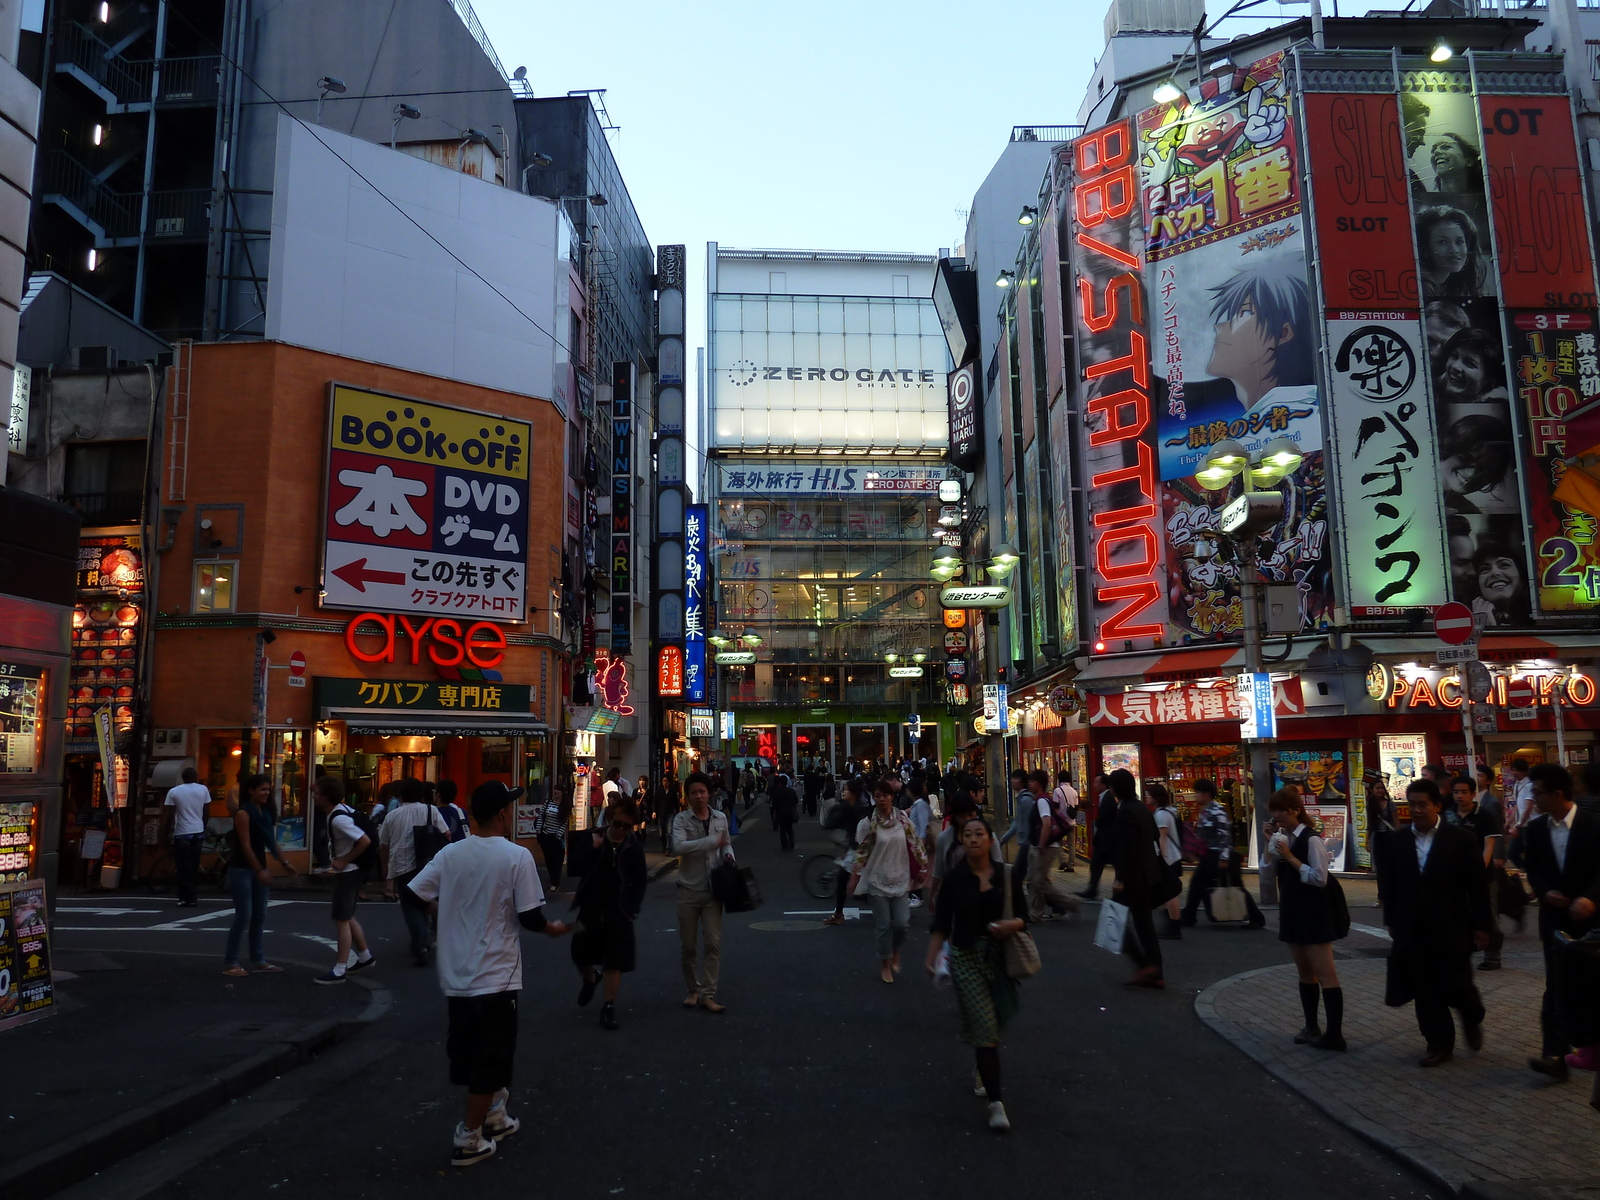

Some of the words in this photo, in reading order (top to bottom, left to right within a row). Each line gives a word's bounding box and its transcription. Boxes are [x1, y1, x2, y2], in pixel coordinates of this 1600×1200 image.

[1149, 177, 1189, 211] 2F
[1336, 217, 1388, 232] SLOT
[1339, 312, 1405, 320] BB/STATION
[1535, 315, 1570, 329] 3F
[1160, 265, 1187, 420] パチンコも最高だね。
[763, 367, 849, 381] ZERO
[856, 368, 934, 382] GATE
[1072, 119, 1164, 641] BB/STATION
[953, 412, 974, 432] NIJYU
[953, 427, 975, 444] MARU
[959, 442, 969, 455] 5F
[727, 471, 803, 489] 海外旅行
[897, 481, 923, 490] GATE
[335, 465, 428, 537] 本
[445, 475, 520, 516] DVD
[440, 513, 520, 554] ゲーム
[411, 558, 519, 591] この先すぐ
[411, 589, 518, 612] クラブクアトロ下
[945, 592, 1007, 601] 渋谷センター街
[1438, 650, 1476, 661] 自転車を除く
[1482, 651, 1550, 660] B/STATION
[1, 664, 17, 675] 5F
[357, 681, 429, 705] ケバブ
[438, 684, 502, 708] 専門店
